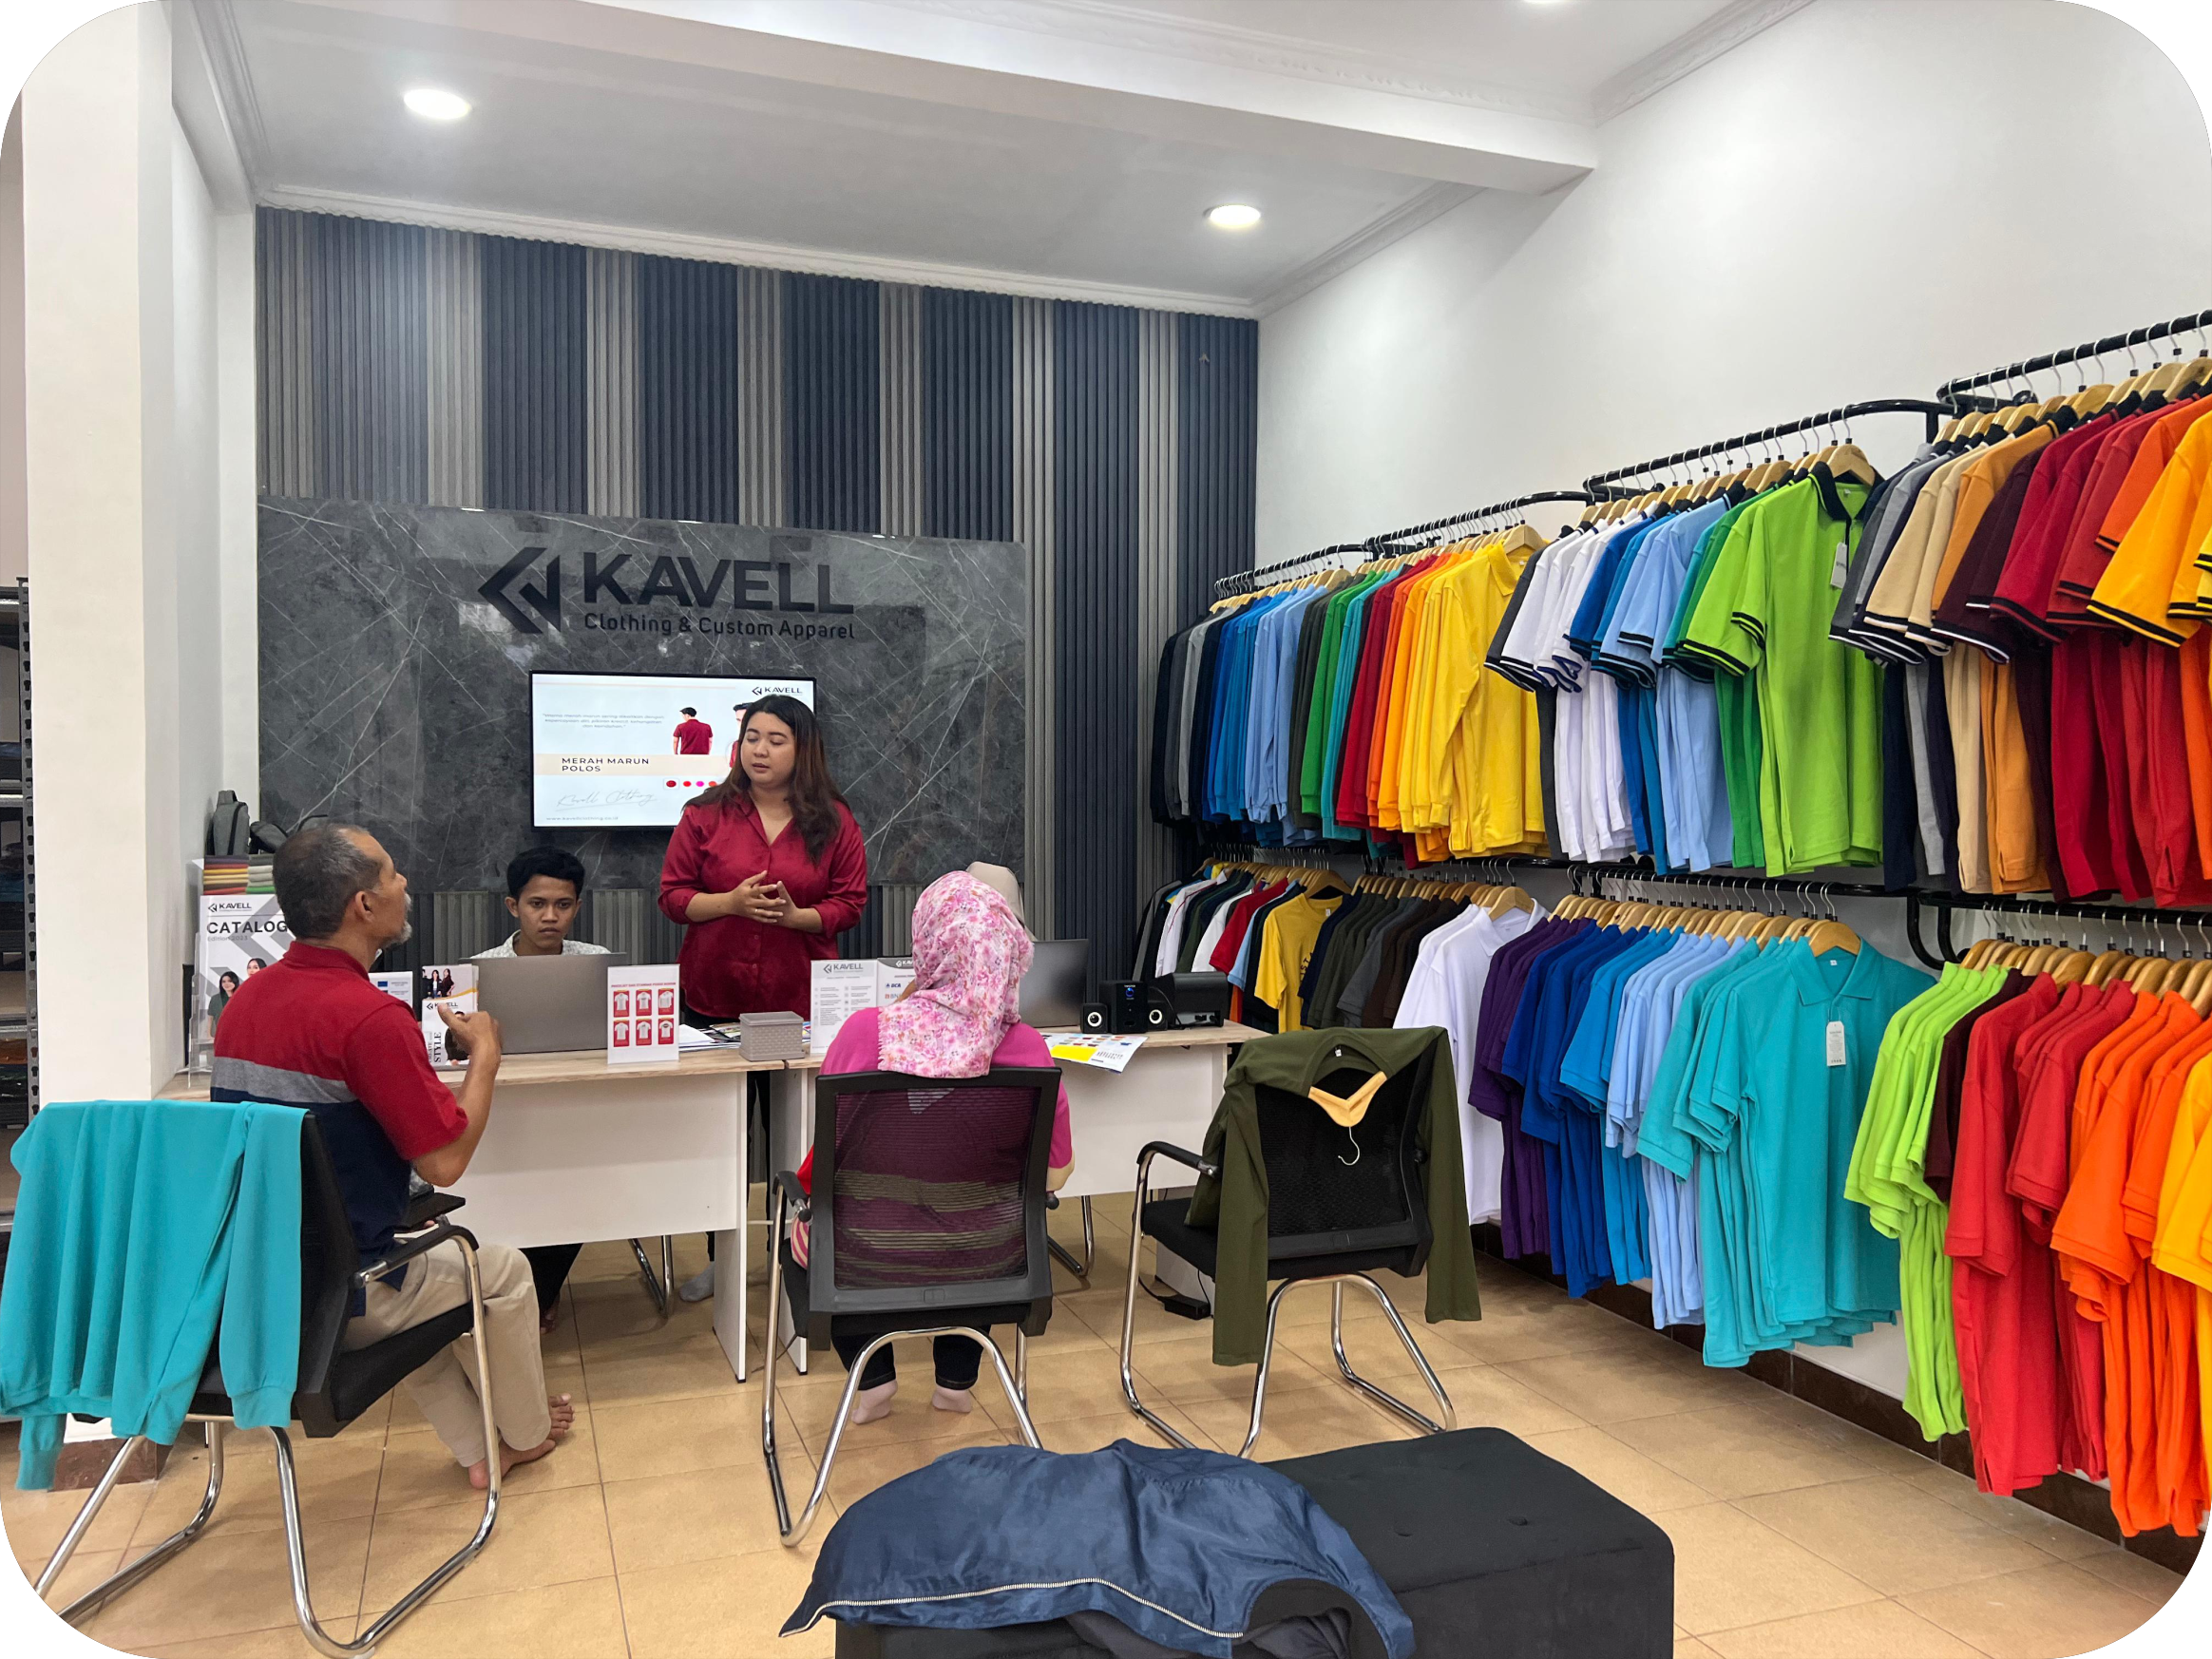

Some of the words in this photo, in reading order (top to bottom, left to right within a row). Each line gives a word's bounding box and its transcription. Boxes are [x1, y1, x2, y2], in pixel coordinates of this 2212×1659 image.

[583, 552, 854, 614] KAVELL
[584, 613, 672, 636] Clothing
[678, 618, 692, 633] &
[698, 618, 773, 636] Custom
[779, 620, 855, 639] Apparel
[206, 921, 288, 934] CATALOG
